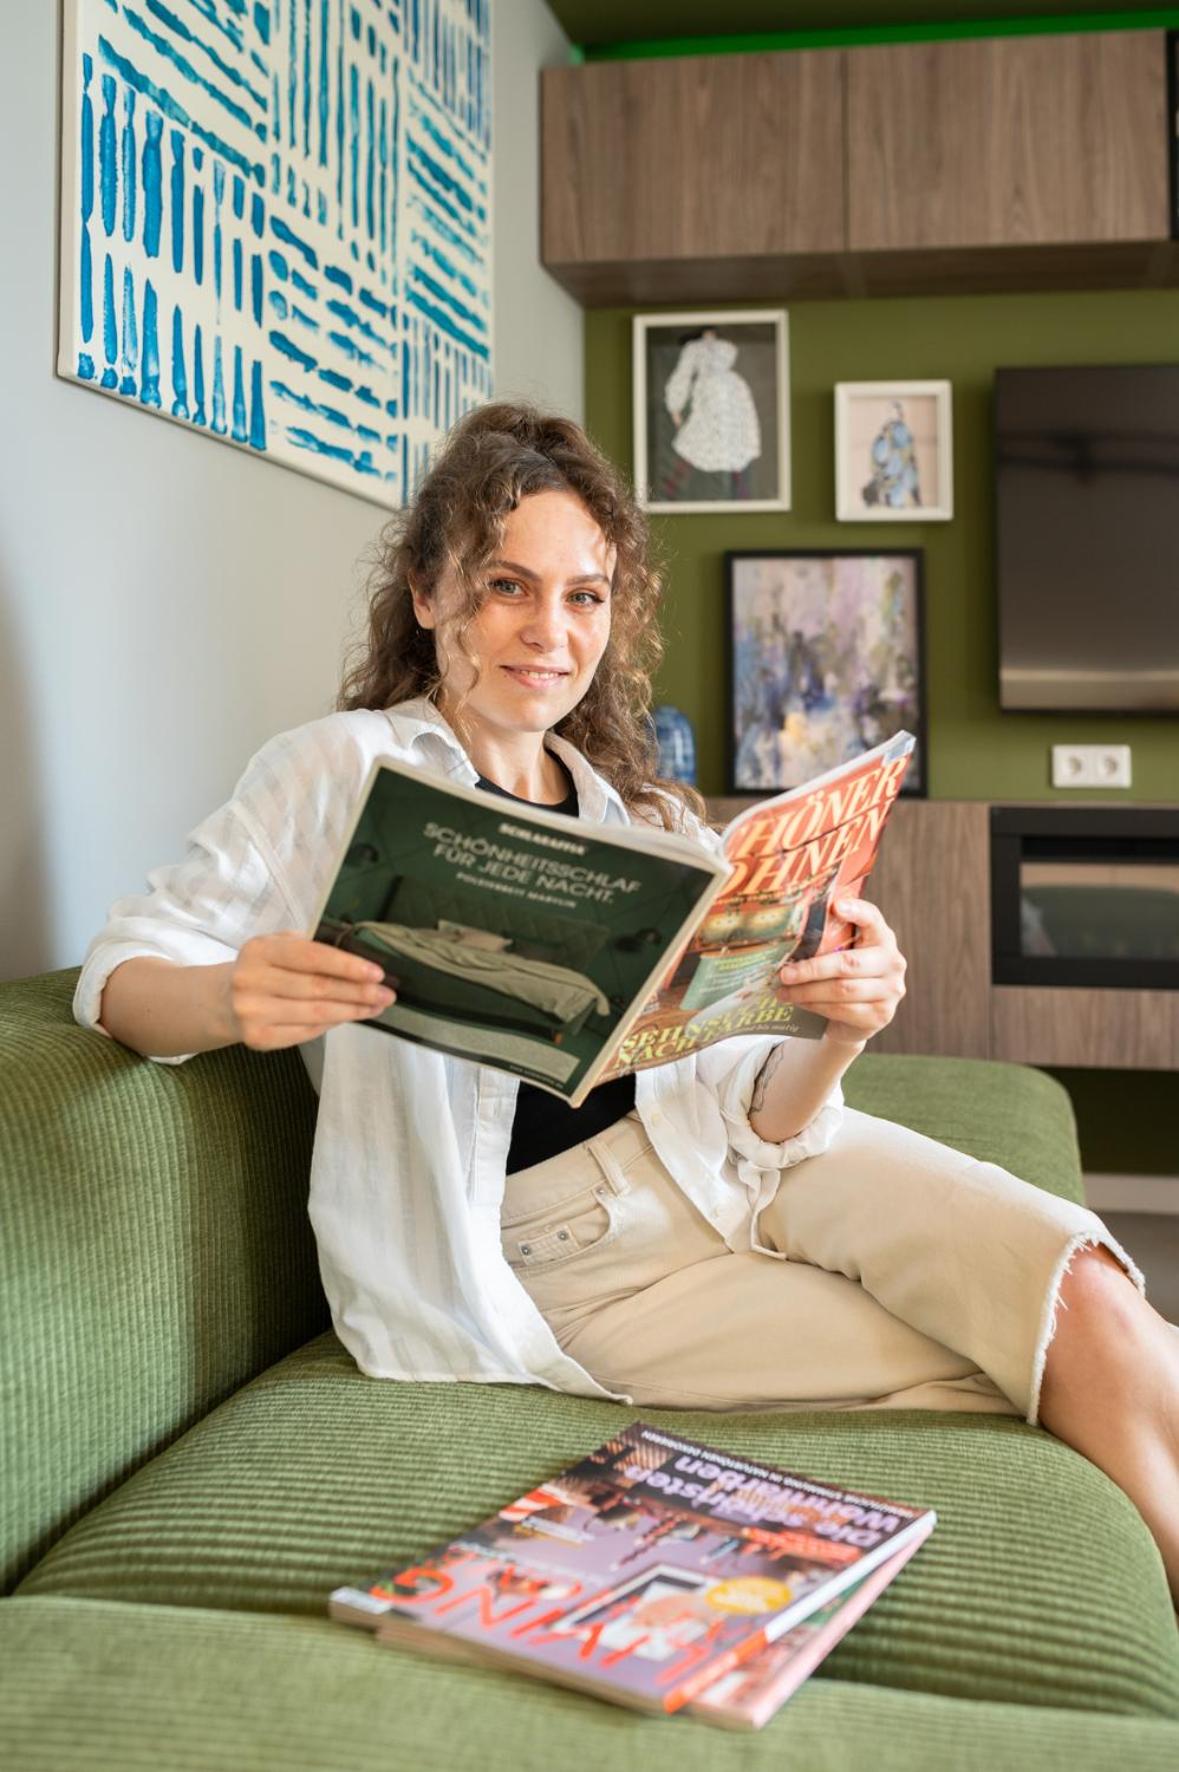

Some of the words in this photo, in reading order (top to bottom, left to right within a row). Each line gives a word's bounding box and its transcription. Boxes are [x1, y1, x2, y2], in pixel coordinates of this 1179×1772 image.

[422, 821, 642, 894] SCHÖNHEITSSCHLAF
[433, 843, 477, 868] FÜR
[478, 860, 530, 884] JEDE
[535, 874, 614, 904] NACHT.
[717, 797, 896, 900] OHNEN
[623, 1464, 806, 1528] schönsten
[673, 1456, 901, 1532] Wohnfarben
[814, 1522, 882, 1548] Die
